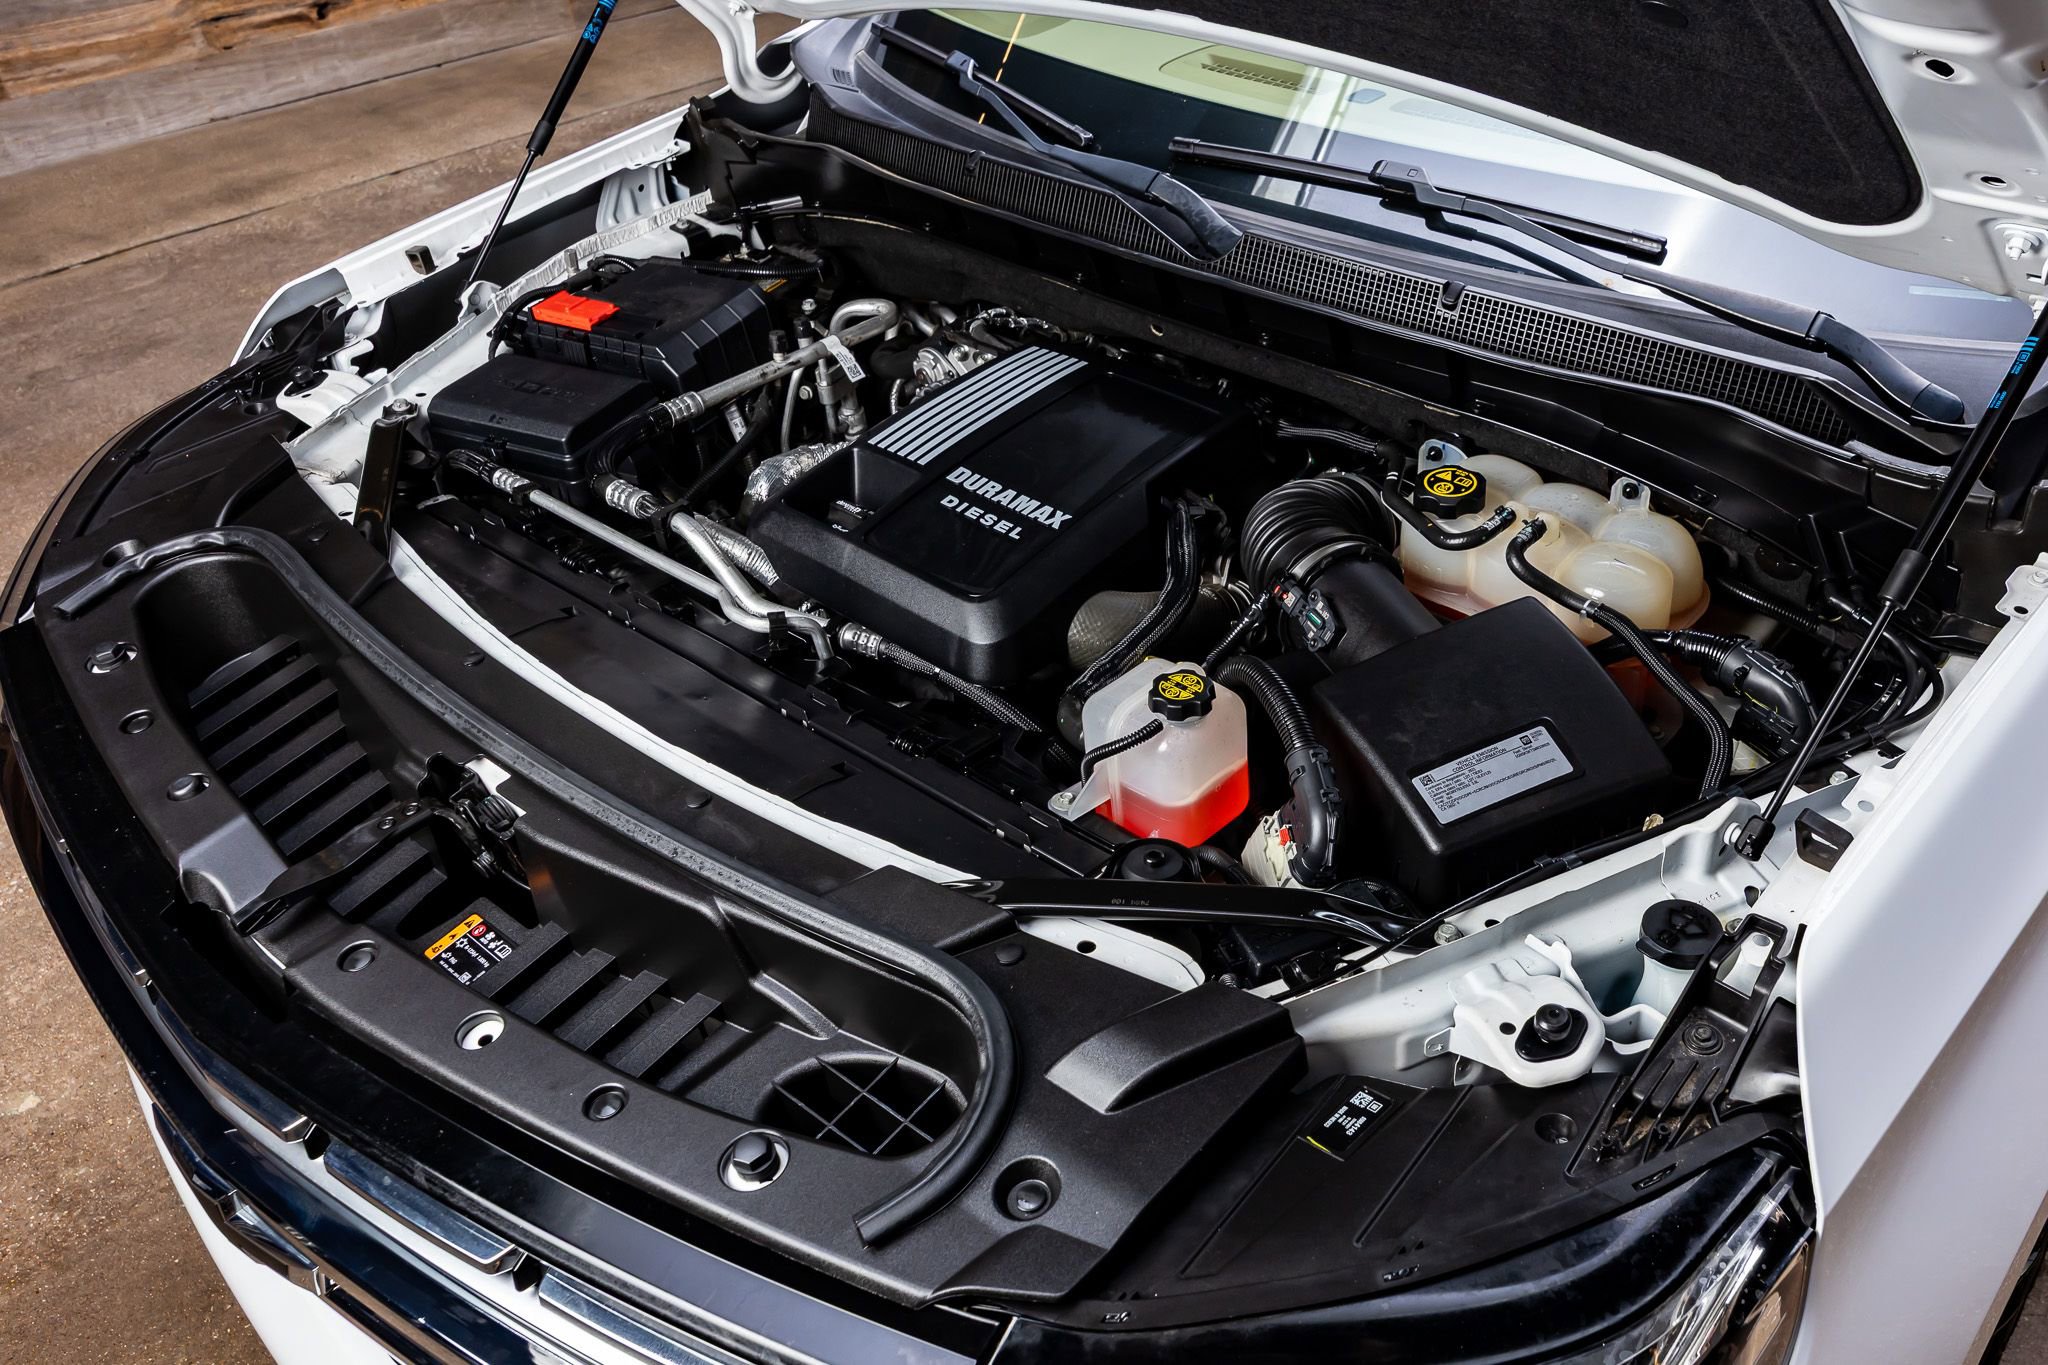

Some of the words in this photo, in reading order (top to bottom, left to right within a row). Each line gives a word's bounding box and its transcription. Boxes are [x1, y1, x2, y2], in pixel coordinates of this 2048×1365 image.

[946, 466, 1072, 530] DURAMAX
[940, 494, 1024, 540] DIESEL
[1452, 761, 1474, 772] CONTROL
[1474, 748, 1506, 762] INFORMATION
[1456, 756, 1475, 765] VEHICLE
[1475, 746, 1498, 757] EMISSION
